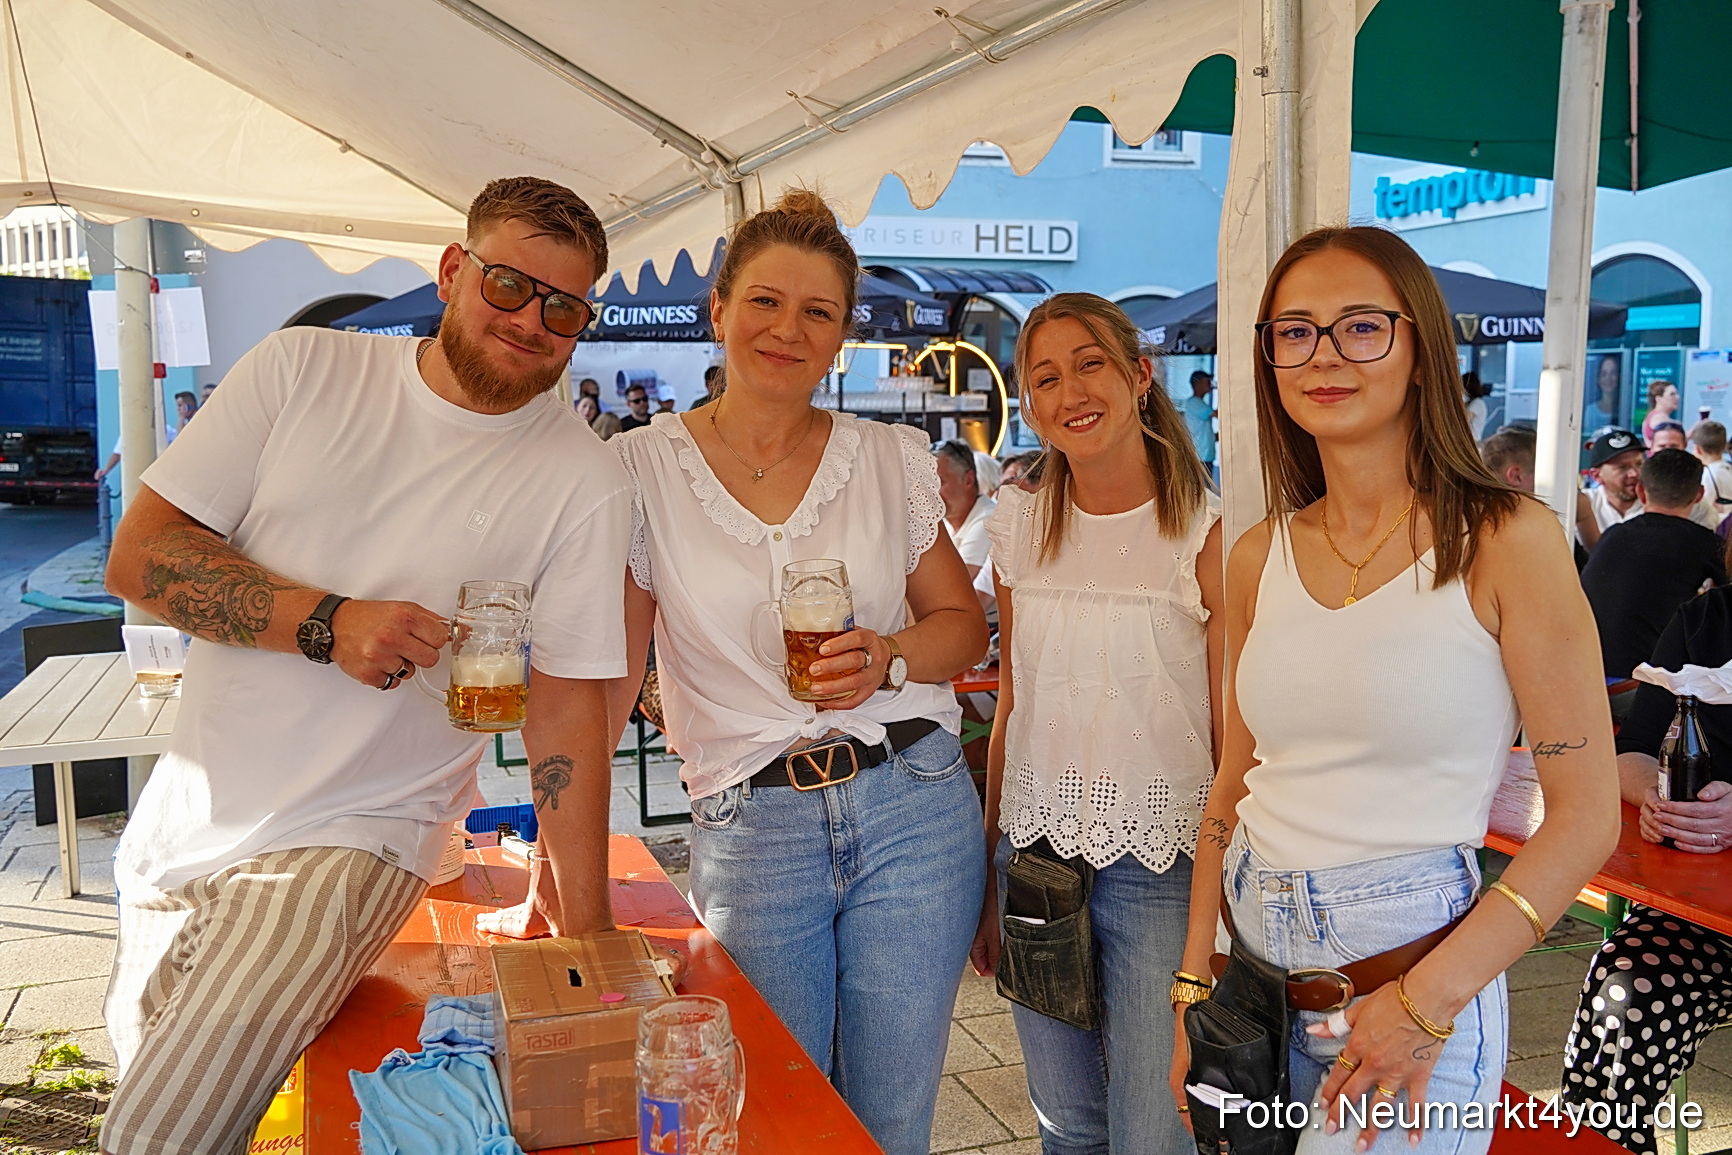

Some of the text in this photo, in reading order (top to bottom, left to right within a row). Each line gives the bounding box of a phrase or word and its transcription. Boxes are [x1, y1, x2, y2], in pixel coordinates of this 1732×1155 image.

[974, 223, 1073, 255] HELD
[602, 304, 699, 326] GUINNESS
[1480, 315, 1546, 338] GUINN
